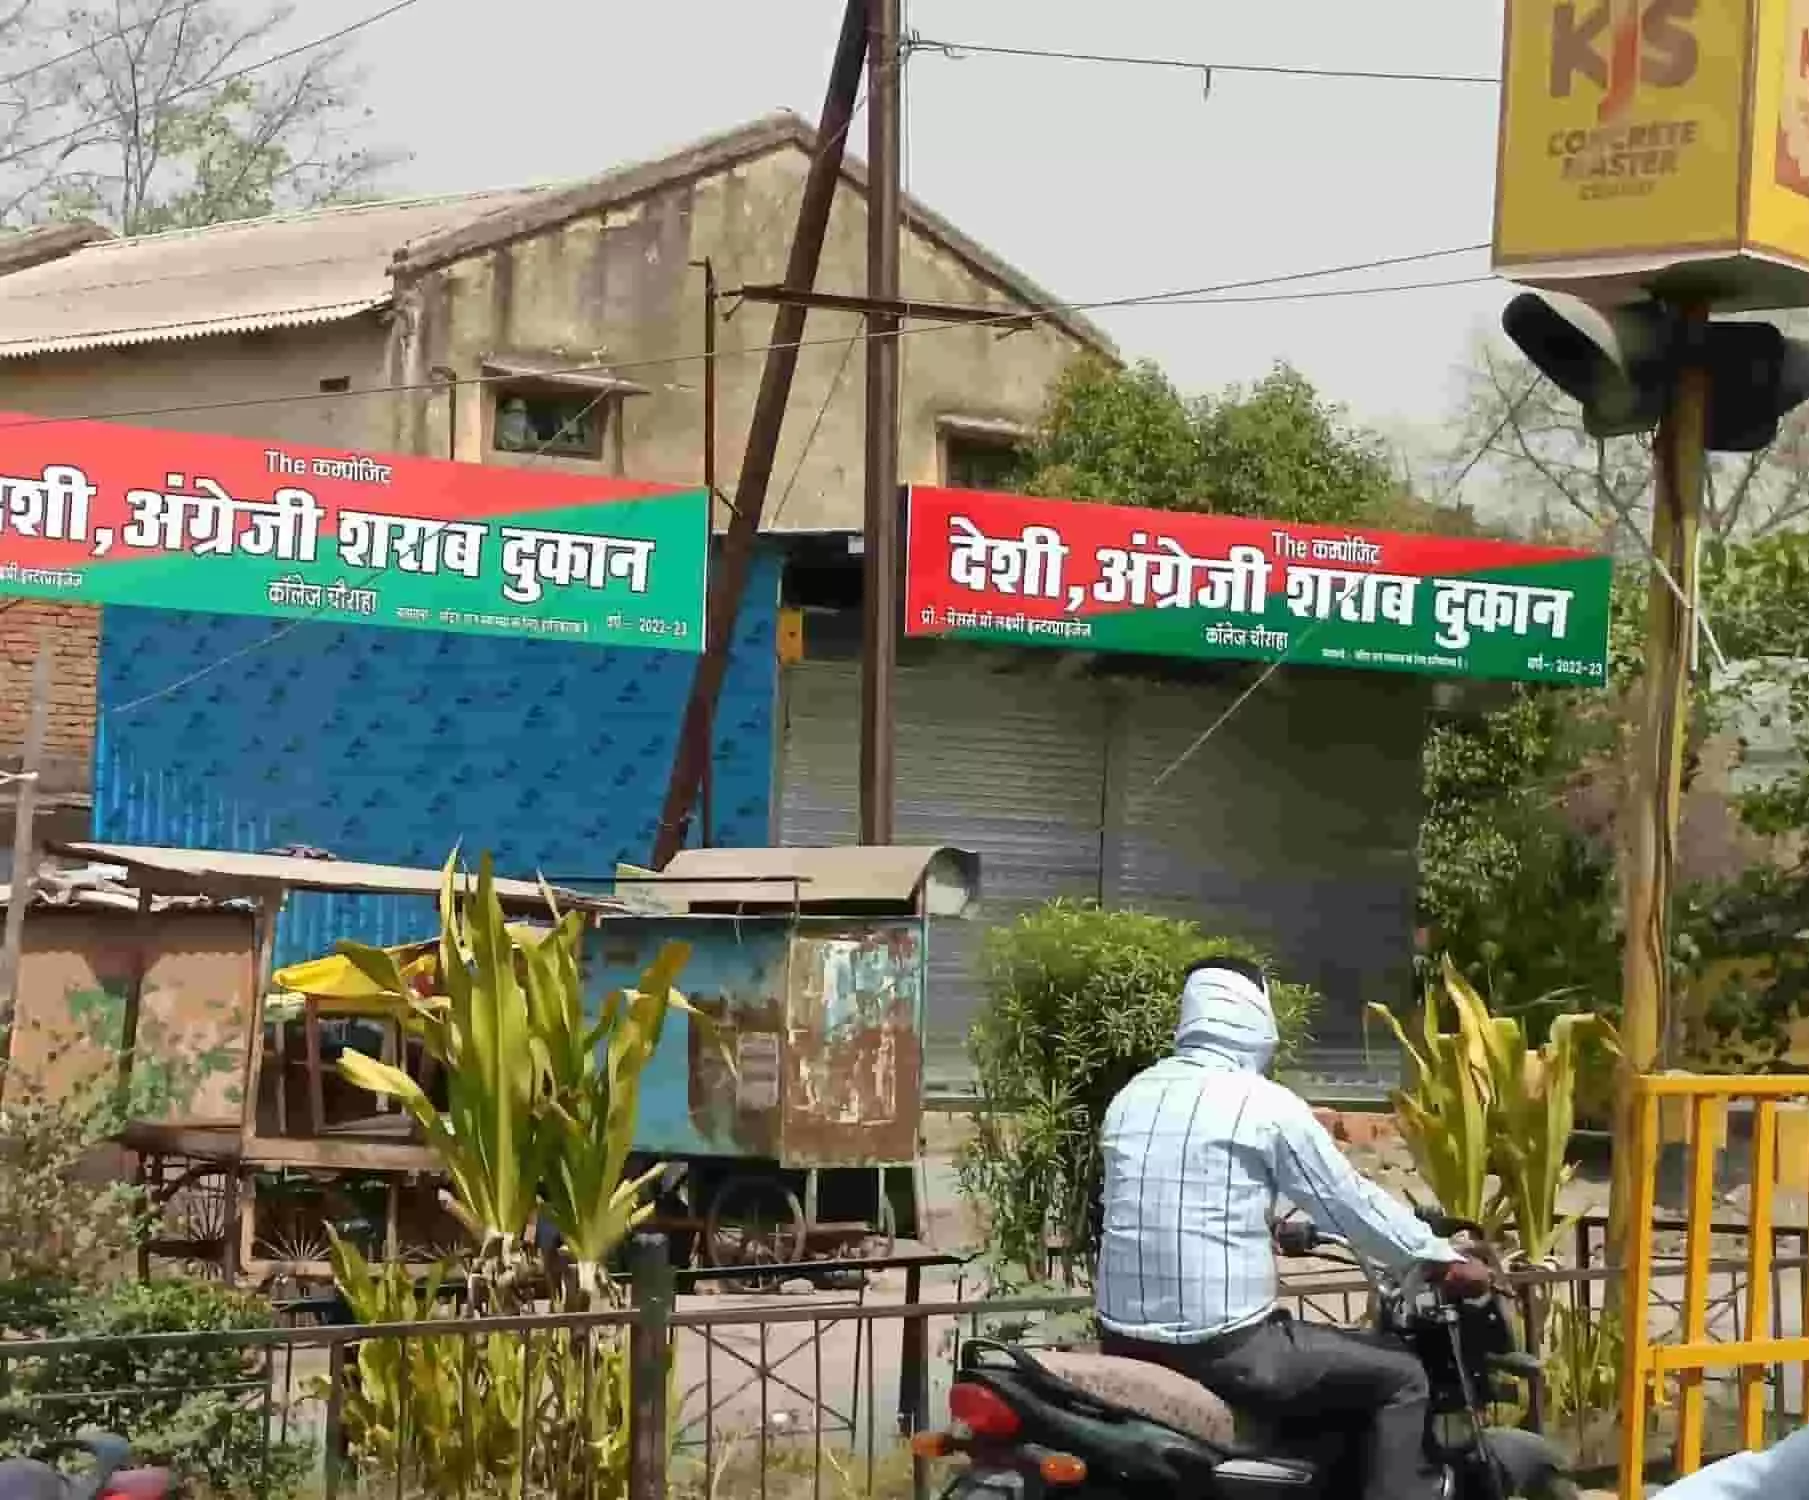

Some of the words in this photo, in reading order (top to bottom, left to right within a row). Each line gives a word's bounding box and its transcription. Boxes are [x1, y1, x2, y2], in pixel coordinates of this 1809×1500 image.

[264, 449, 305, 474] The
[337, 508, 488, 577] शराब
[500, 526, 656, 604] दुकान
[1272, 531, 1306, 559] The
[1286, 564, 1421, 626] शराब
[1432, 576, 1573, 650] दुकान
[639, 615, 689, 637] 2022-23
[1205, 621, 1248, 648] कॉलेज
[1249, 624, 1289, 651] चौराहा
[1555, 658, 1603, 676] 2022-23
